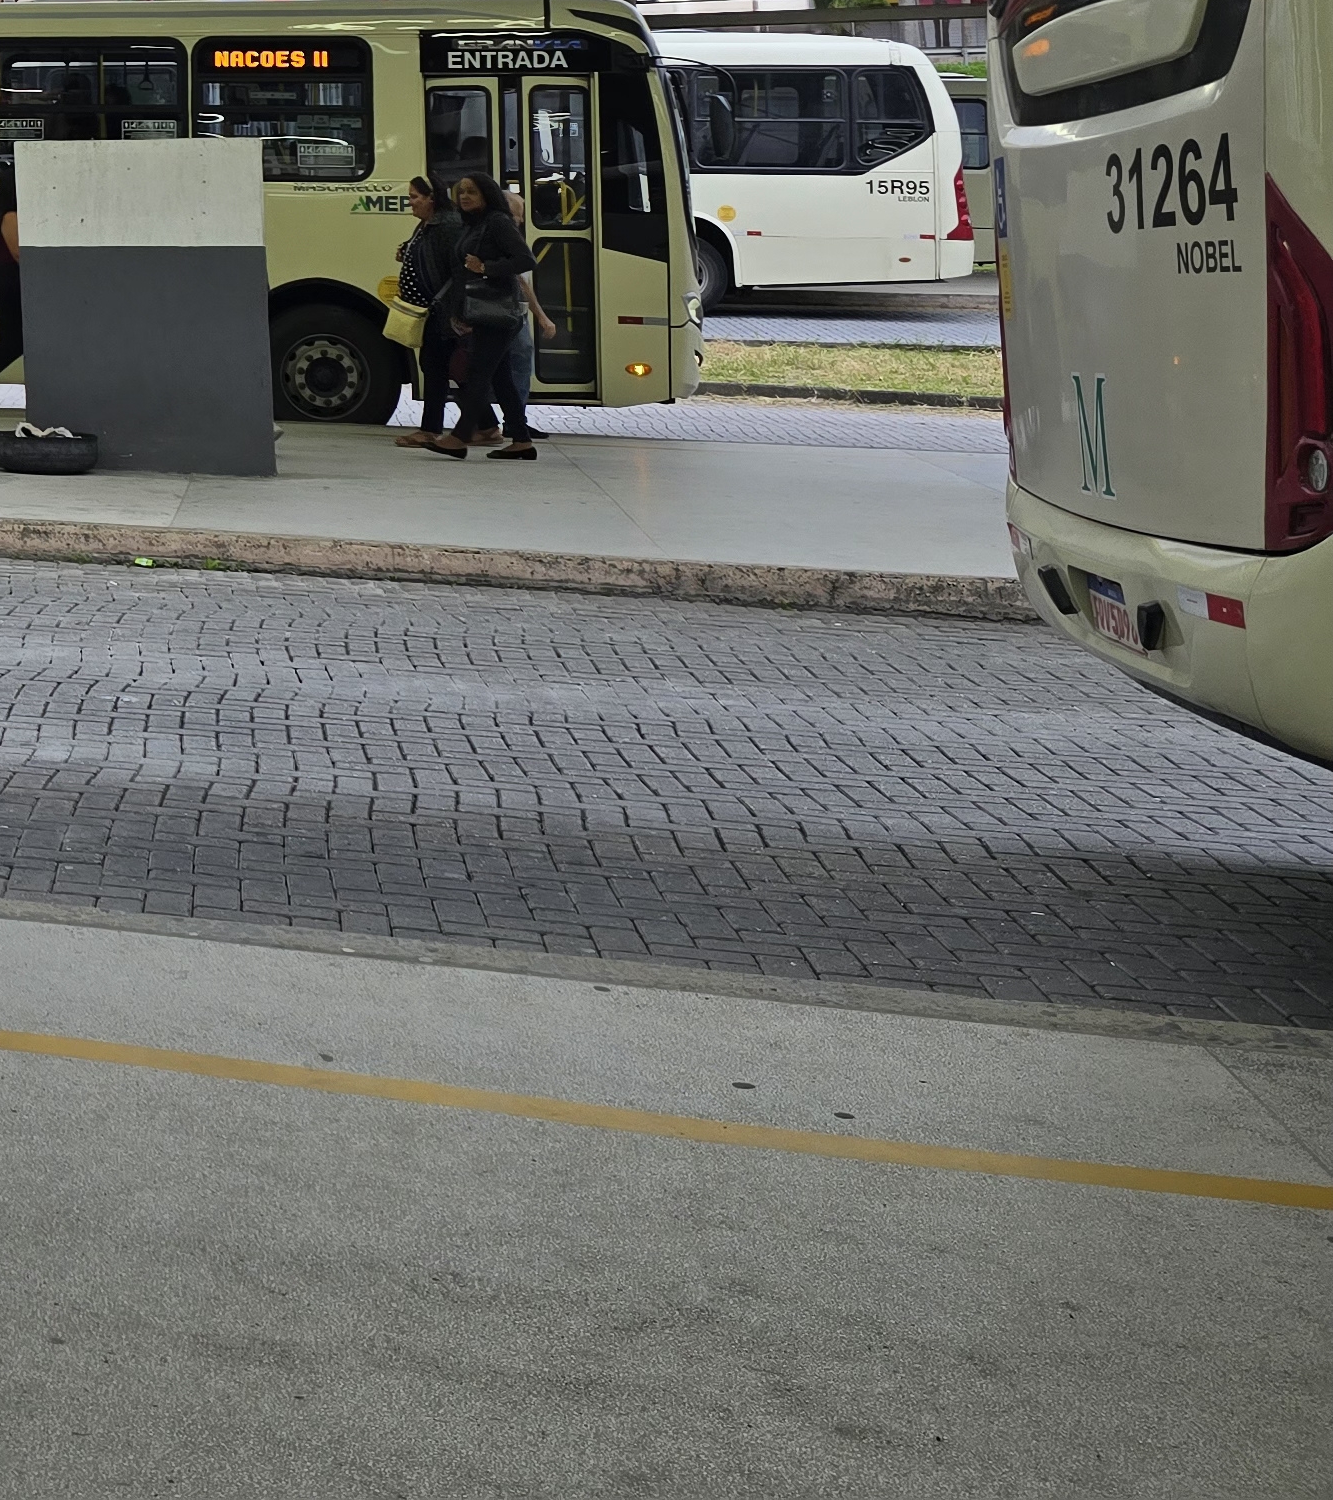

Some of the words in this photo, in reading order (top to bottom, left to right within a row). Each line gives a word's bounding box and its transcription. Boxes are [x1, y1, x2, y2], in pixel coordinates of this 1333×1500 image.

[214, 50, 306, 68] NACOES
[313, 50, 329, 68] II
[447, 50, 569, 69] ENTRADA
[865, 179, 930, 195] 15R95
[1105, 132, 1239, 234] 31264
[1176, 239, 1243, 275] NOBEL
[1072, 375, 1116, 498] M
